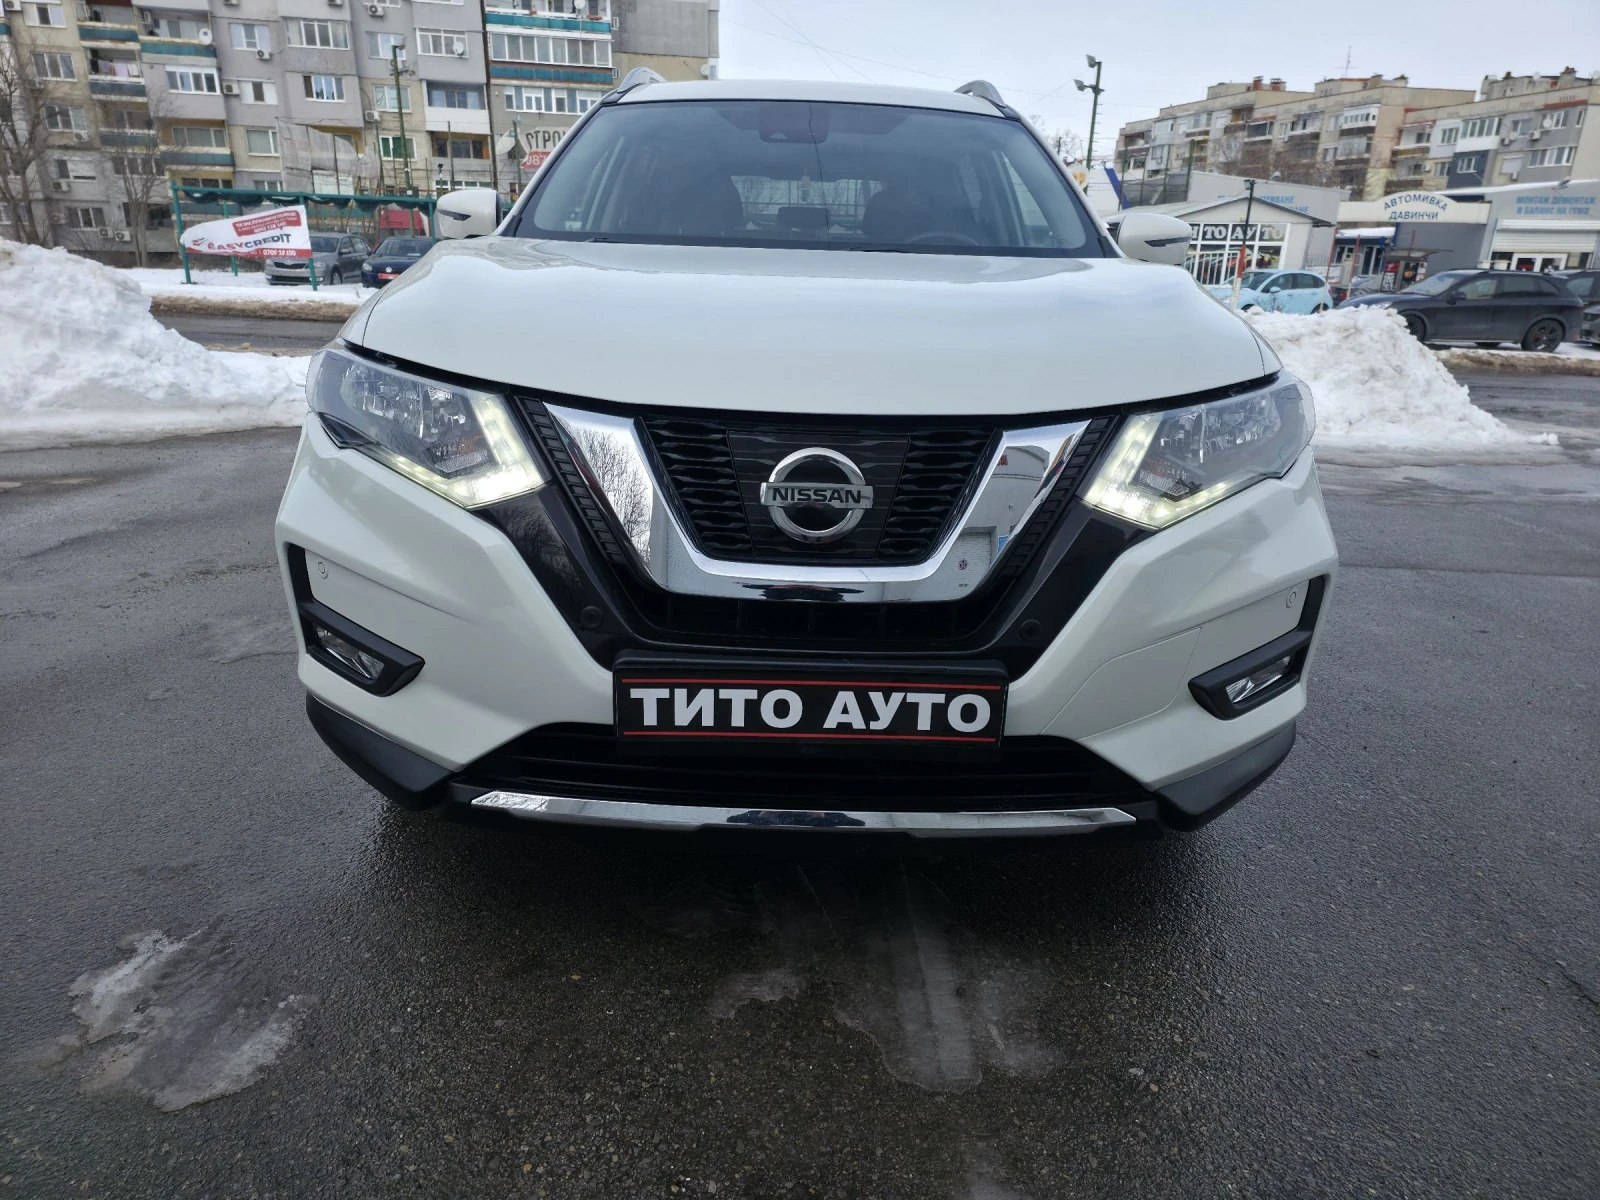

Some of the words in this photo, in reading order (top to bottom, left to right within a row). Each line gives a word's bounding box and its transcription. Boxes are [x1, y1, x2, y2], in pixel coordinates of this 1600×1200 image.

[526, 130, 567, 150] СТРО
[1384, 194, 1448, 211] АВТОМИВКА
[1389, 211, 1439, 220] ДАВИНЧИ
[772, 488, 861, 504] NISSAN
[630, 688, 803, 729] ТИТО
[823, 690, 991, 733] АУТО
